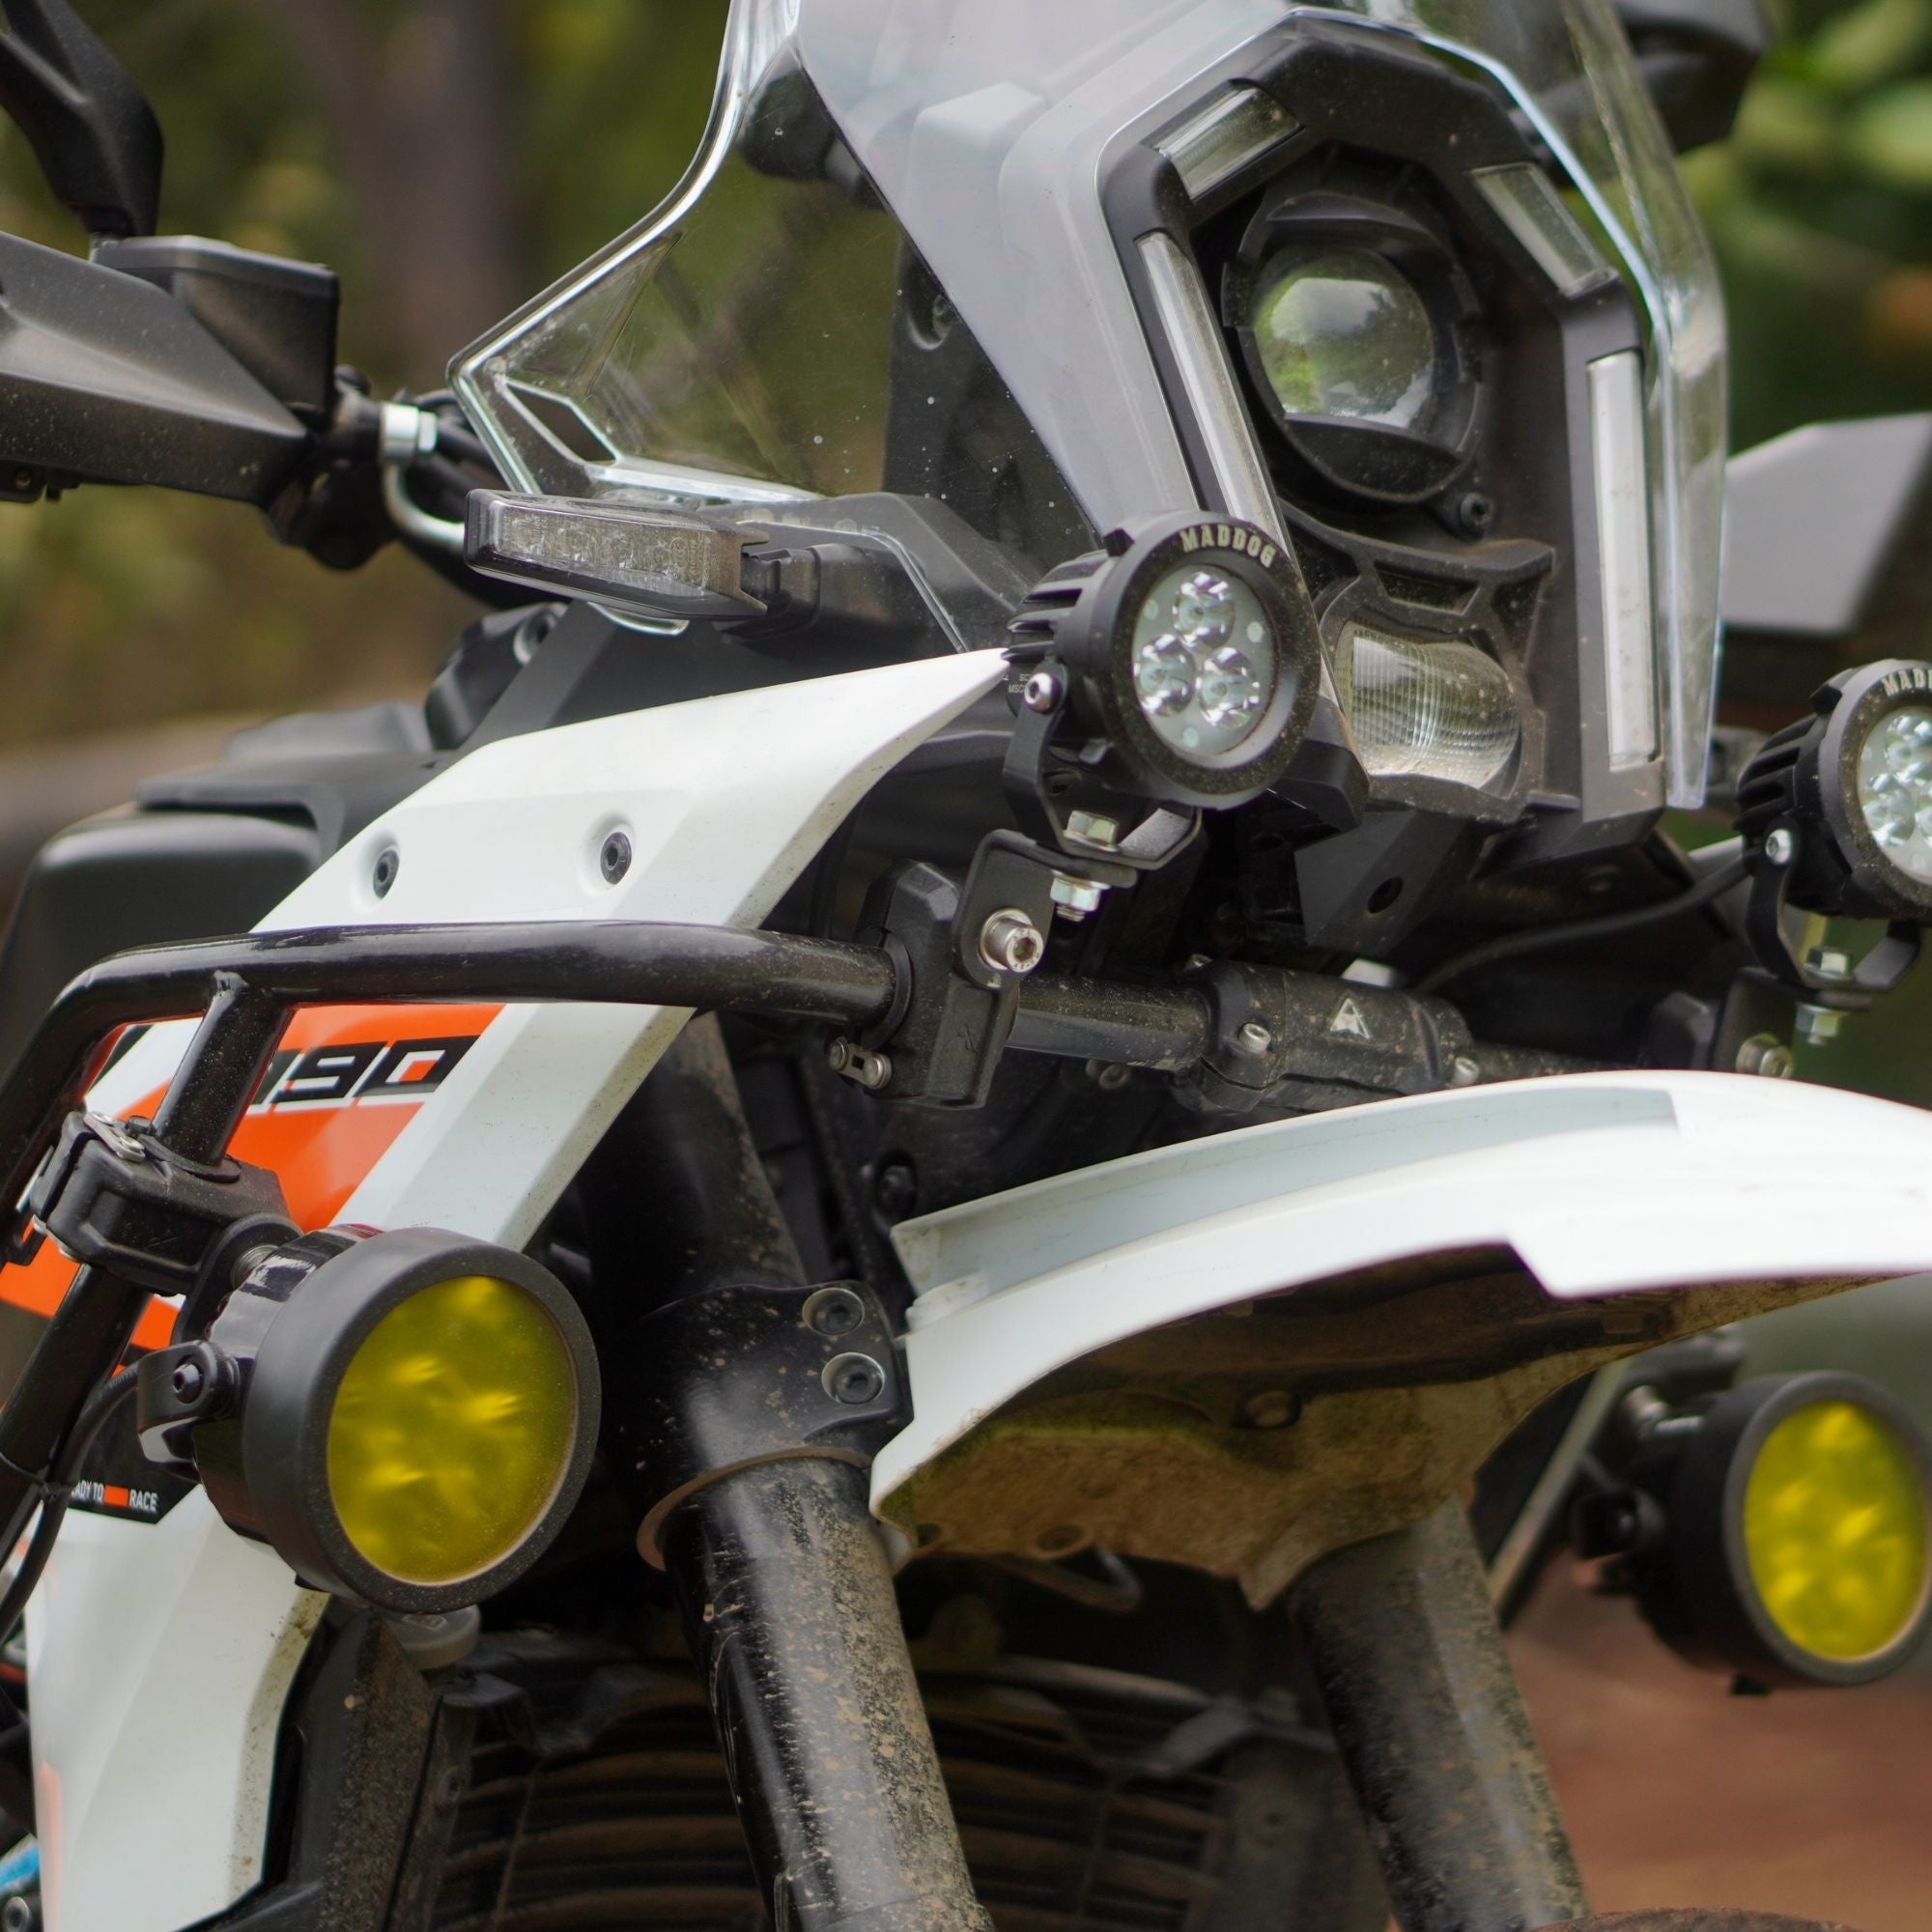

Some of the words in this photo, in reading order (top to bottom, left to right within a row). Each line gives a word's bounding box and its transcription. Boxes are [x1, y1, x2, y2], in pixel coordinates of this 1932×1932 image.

[1179, 524, 1275, 568] MADDOG
[71, 1480, 93, 1499] ADY
[93, 1483, 104, 1503] TO
[128, 1489, 157, 1513] RACE
